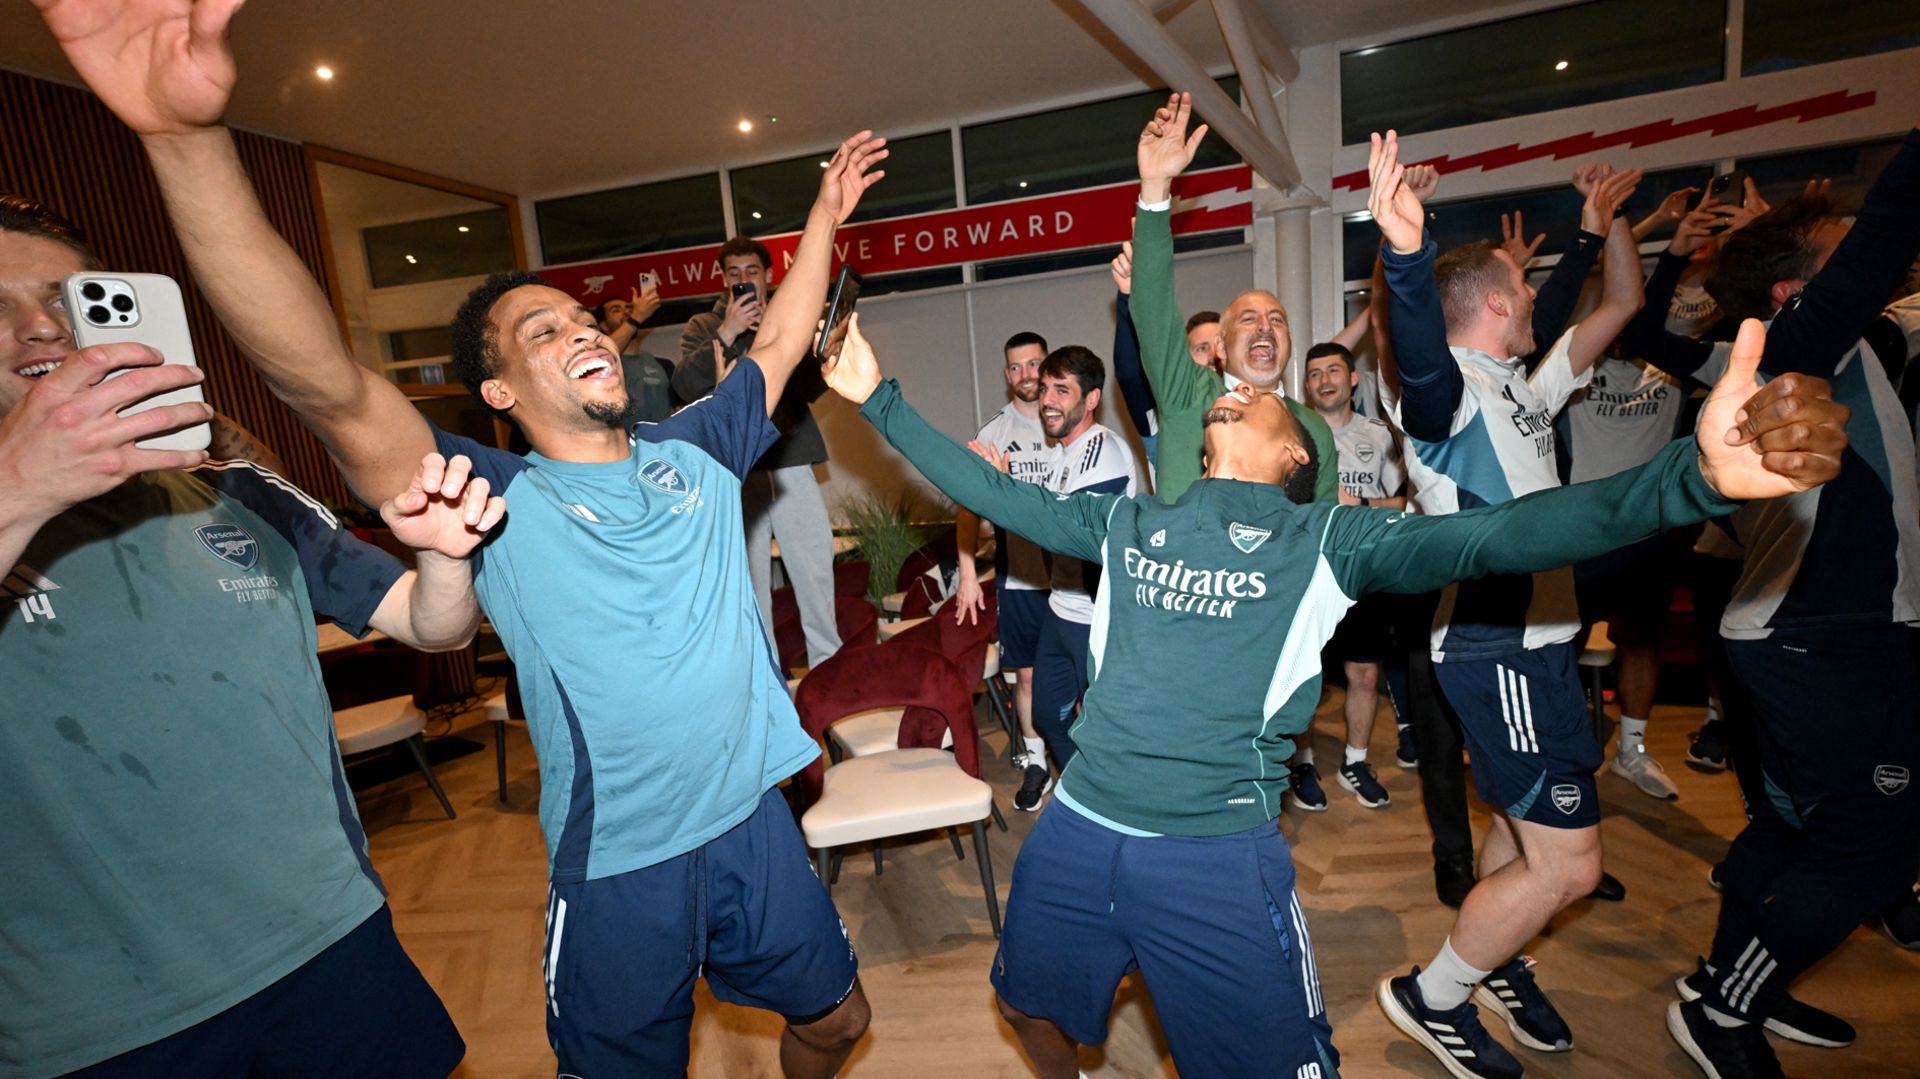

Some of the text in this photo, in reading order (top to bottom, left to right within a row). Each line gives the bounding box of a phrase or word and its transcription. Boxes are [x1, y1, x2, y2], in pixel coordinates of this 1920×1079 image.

[783, 239, 872, 270] MVE
[894, 211, 1073, 256] FORWARD
[1596, 402, 1659, 416] FLY BETTER
[206, 529, 244, 540] Arsenal
[1149, 529, 1166, 547] 49
[1124, 547, 1267, 598] Emirates
[217, 573, 279, 592] Emirates
[236, 591, 251, 603] FLY
[1135, 584, 1237, 619] FLY BETTER
[13, 593, 56, 623] 14
